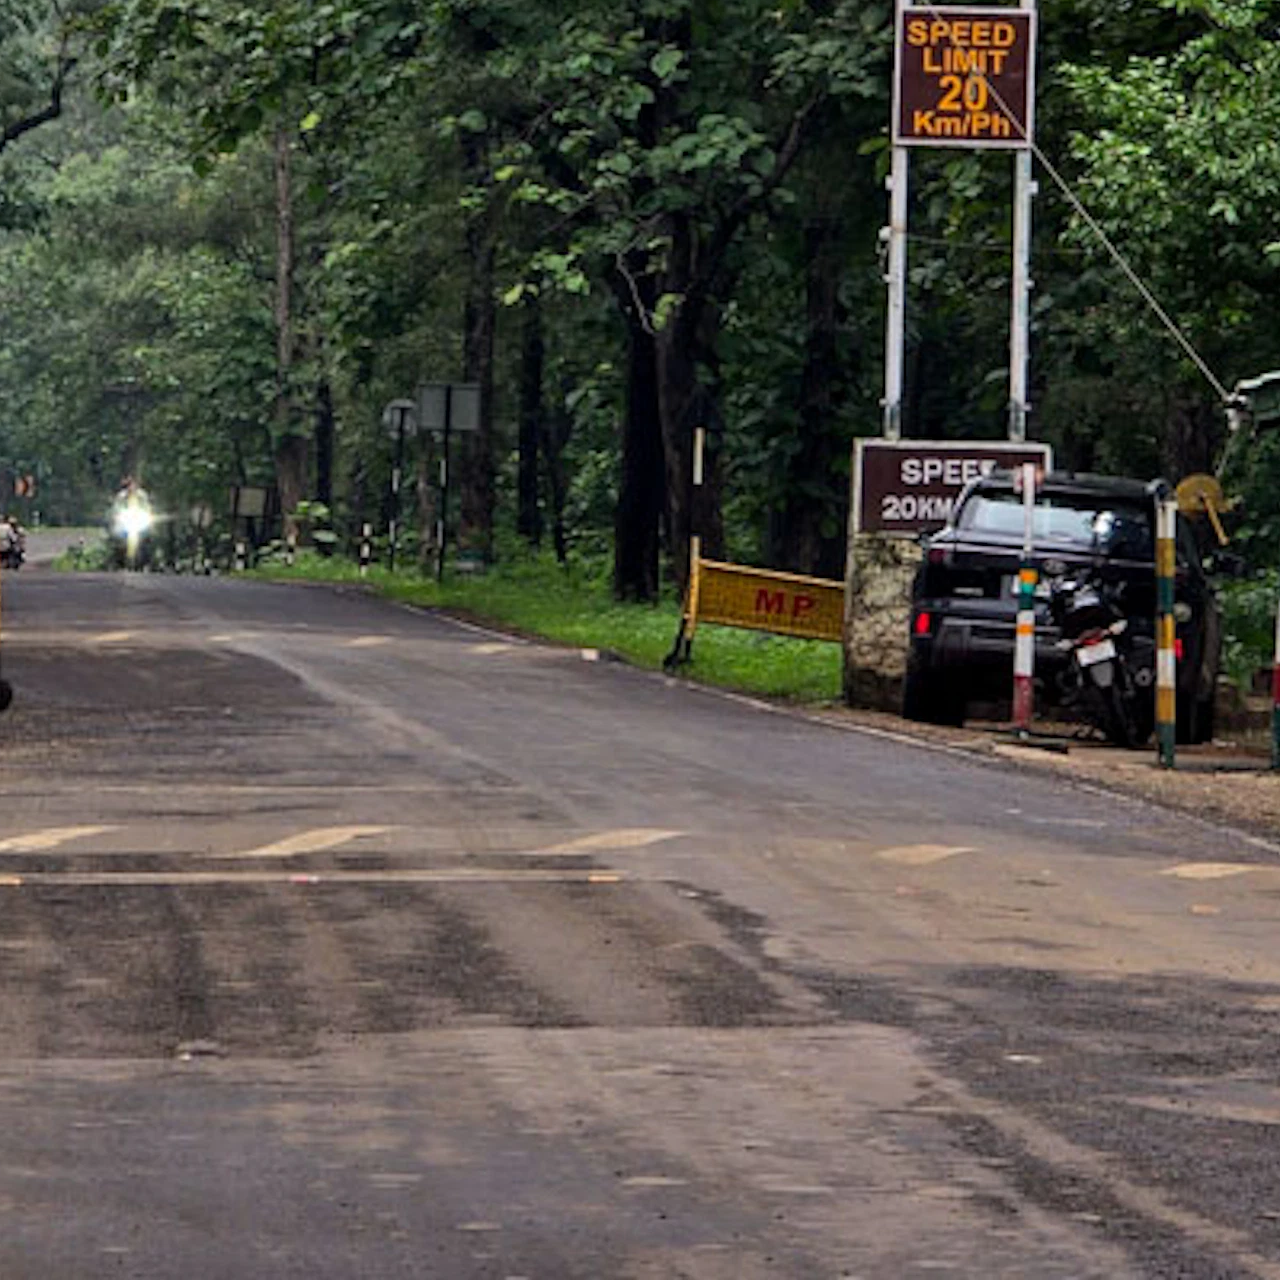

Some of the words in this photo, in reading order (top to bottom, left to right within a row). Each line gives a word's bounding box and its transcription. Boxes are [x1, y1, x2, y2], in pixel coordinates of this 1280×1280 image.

[907, 20, 1016, 46] SPEED
[923, 48, 1009, 74] LIMIT
[938, 75, 987, 110] 20
[913, 111, 1010, 136] Km/Ph
